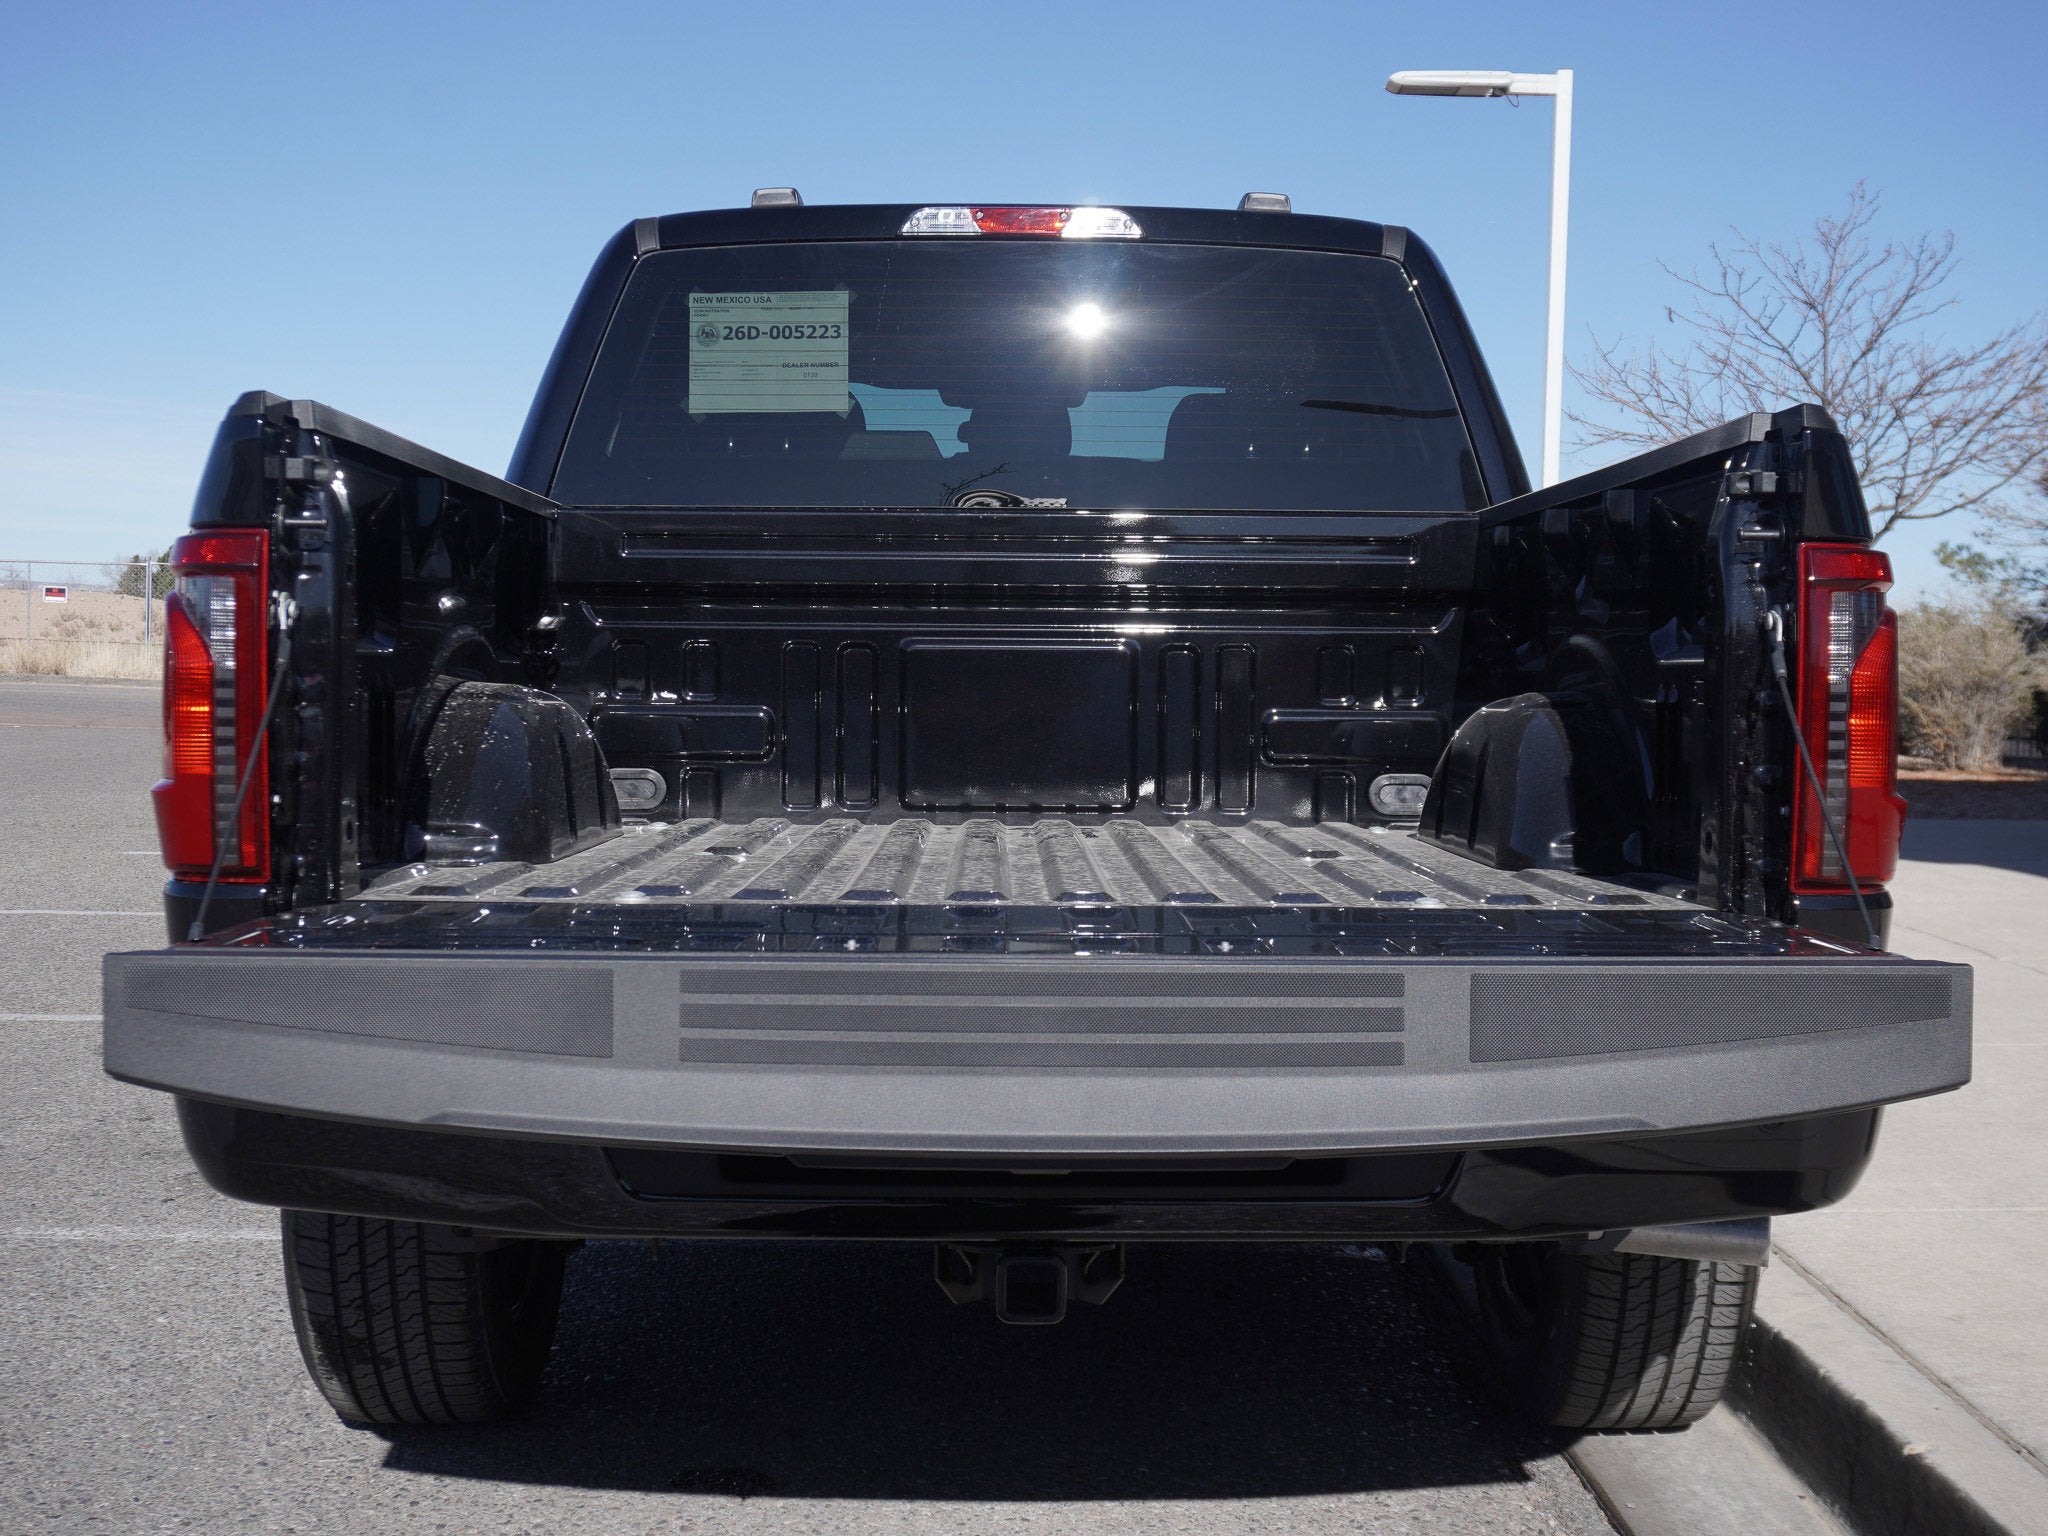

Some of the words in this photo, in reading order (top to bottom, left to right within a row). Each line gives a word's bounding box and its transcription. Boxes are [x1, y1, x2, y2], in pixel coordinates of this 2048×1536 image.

[692, 296, 713, 304] NEW
[715, 296, 751, 304] MEXICO
[753, 295, 772, 304] USA
[722, 324, 842, 341] 26D-005223
